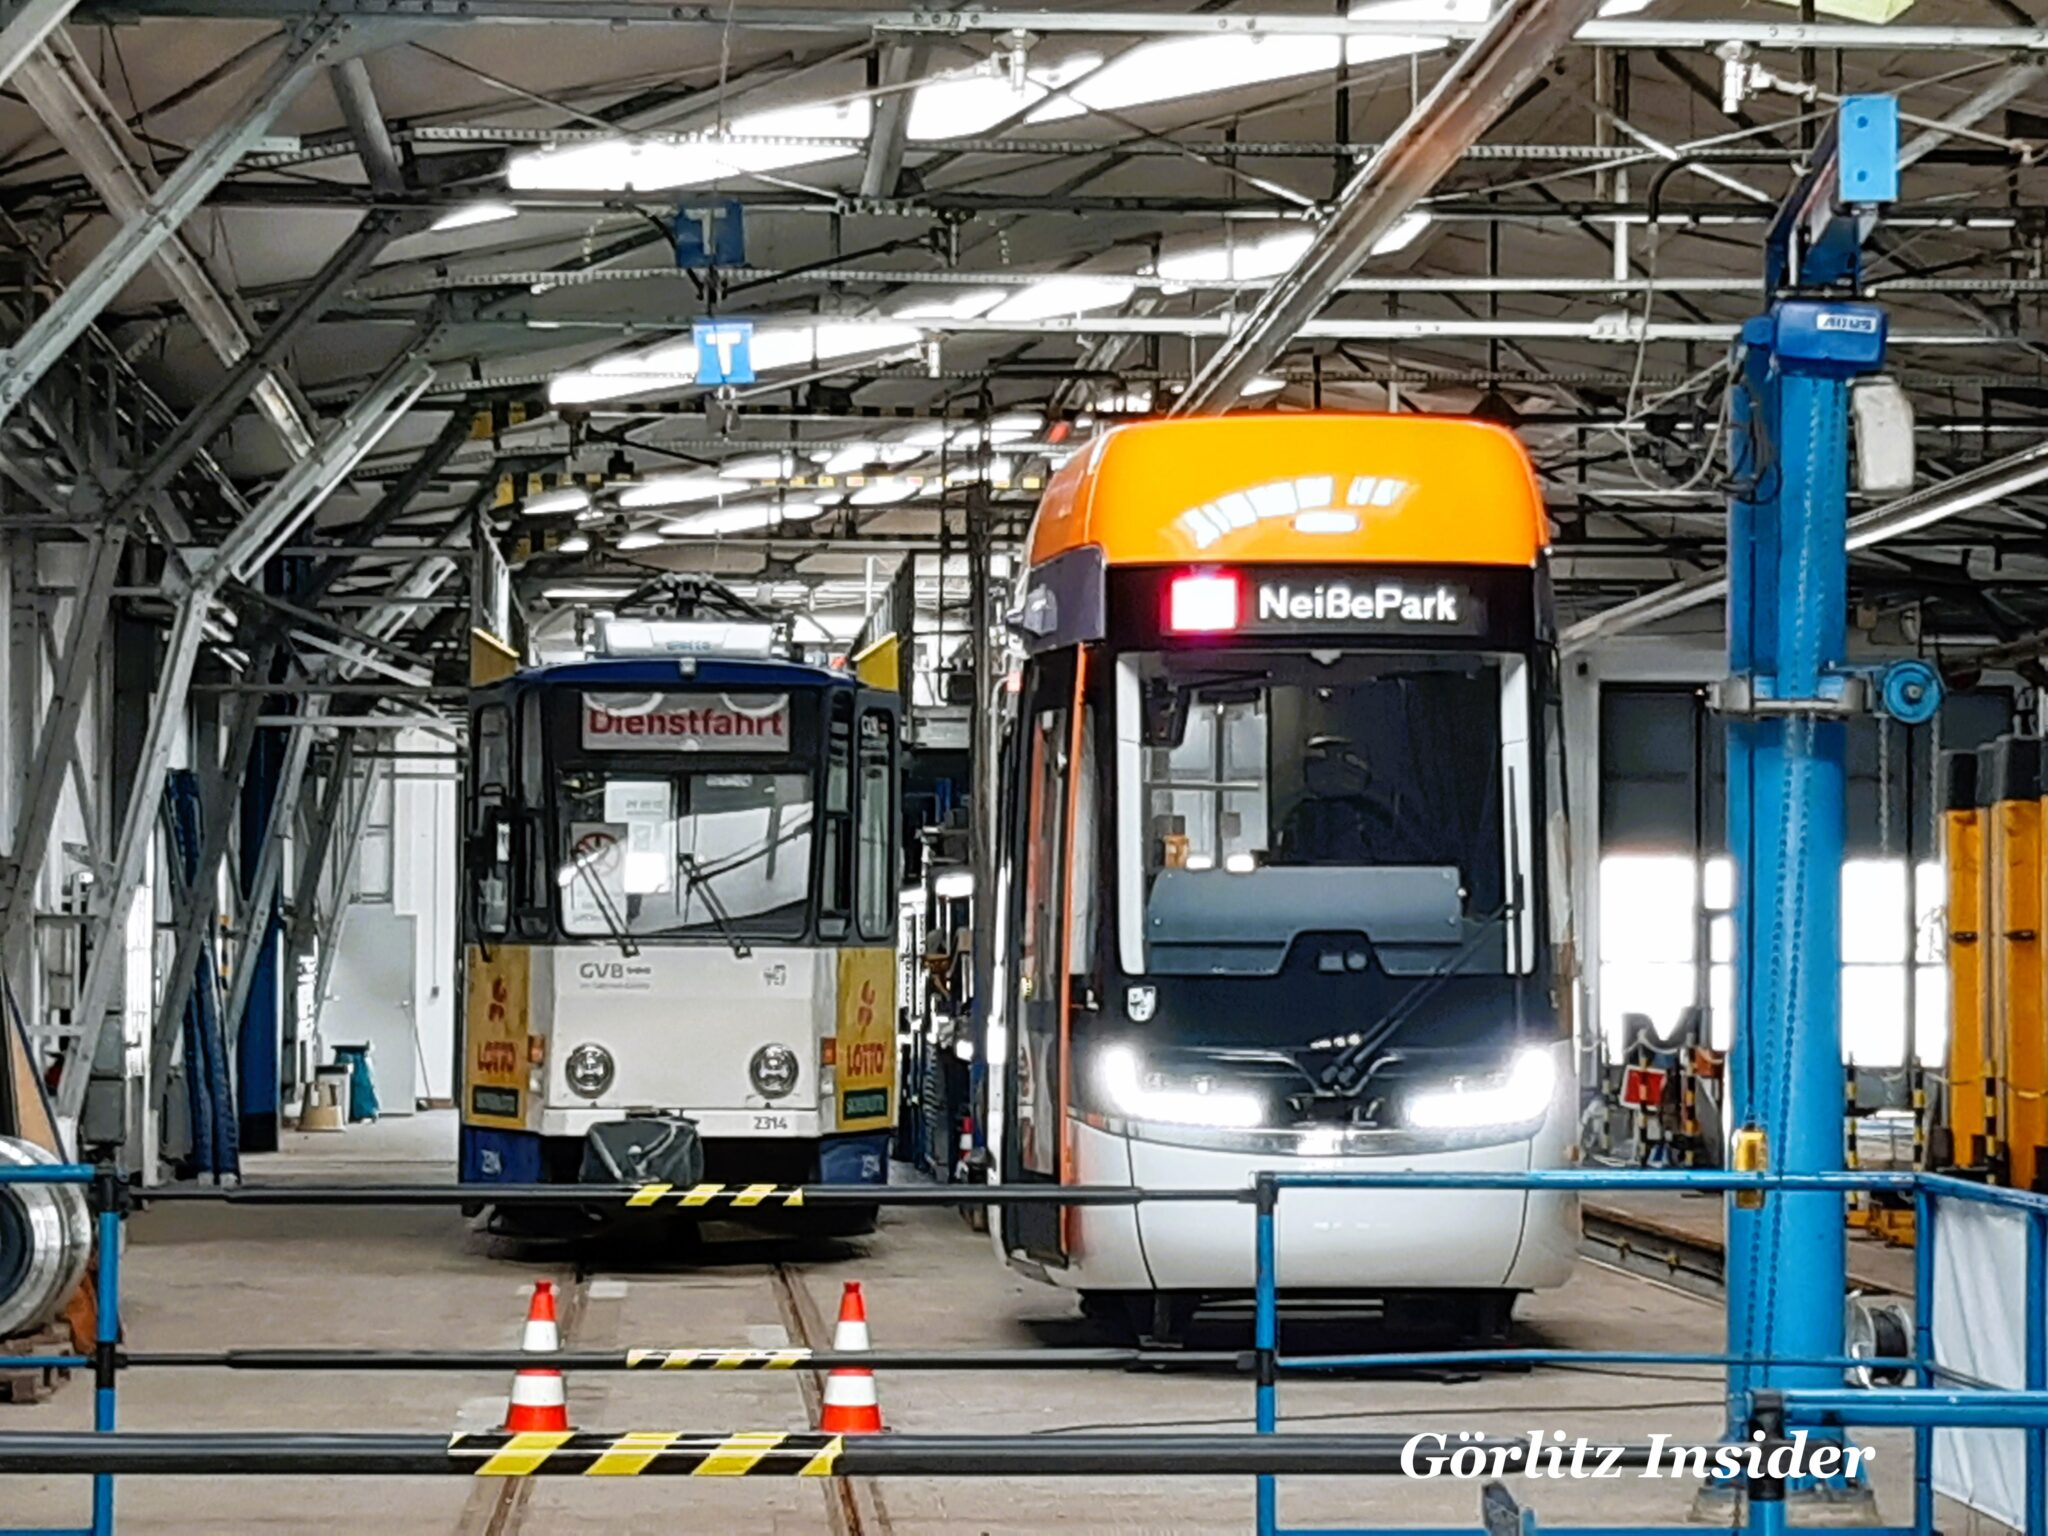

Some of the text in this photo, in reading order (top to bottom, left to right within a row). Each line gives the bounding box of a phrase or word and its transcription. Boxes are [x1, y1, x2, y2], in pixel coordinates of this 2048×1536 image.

[685, 207, 727, 256] T
[705, 332, 742, 376] T
[588, 708, 783, 736] Dienstfahrt
[579, 962, 624, 979] GVB
[846, 1042, 885, 1077] LOTTO
[753, 1115, 788, 1130] 2314
